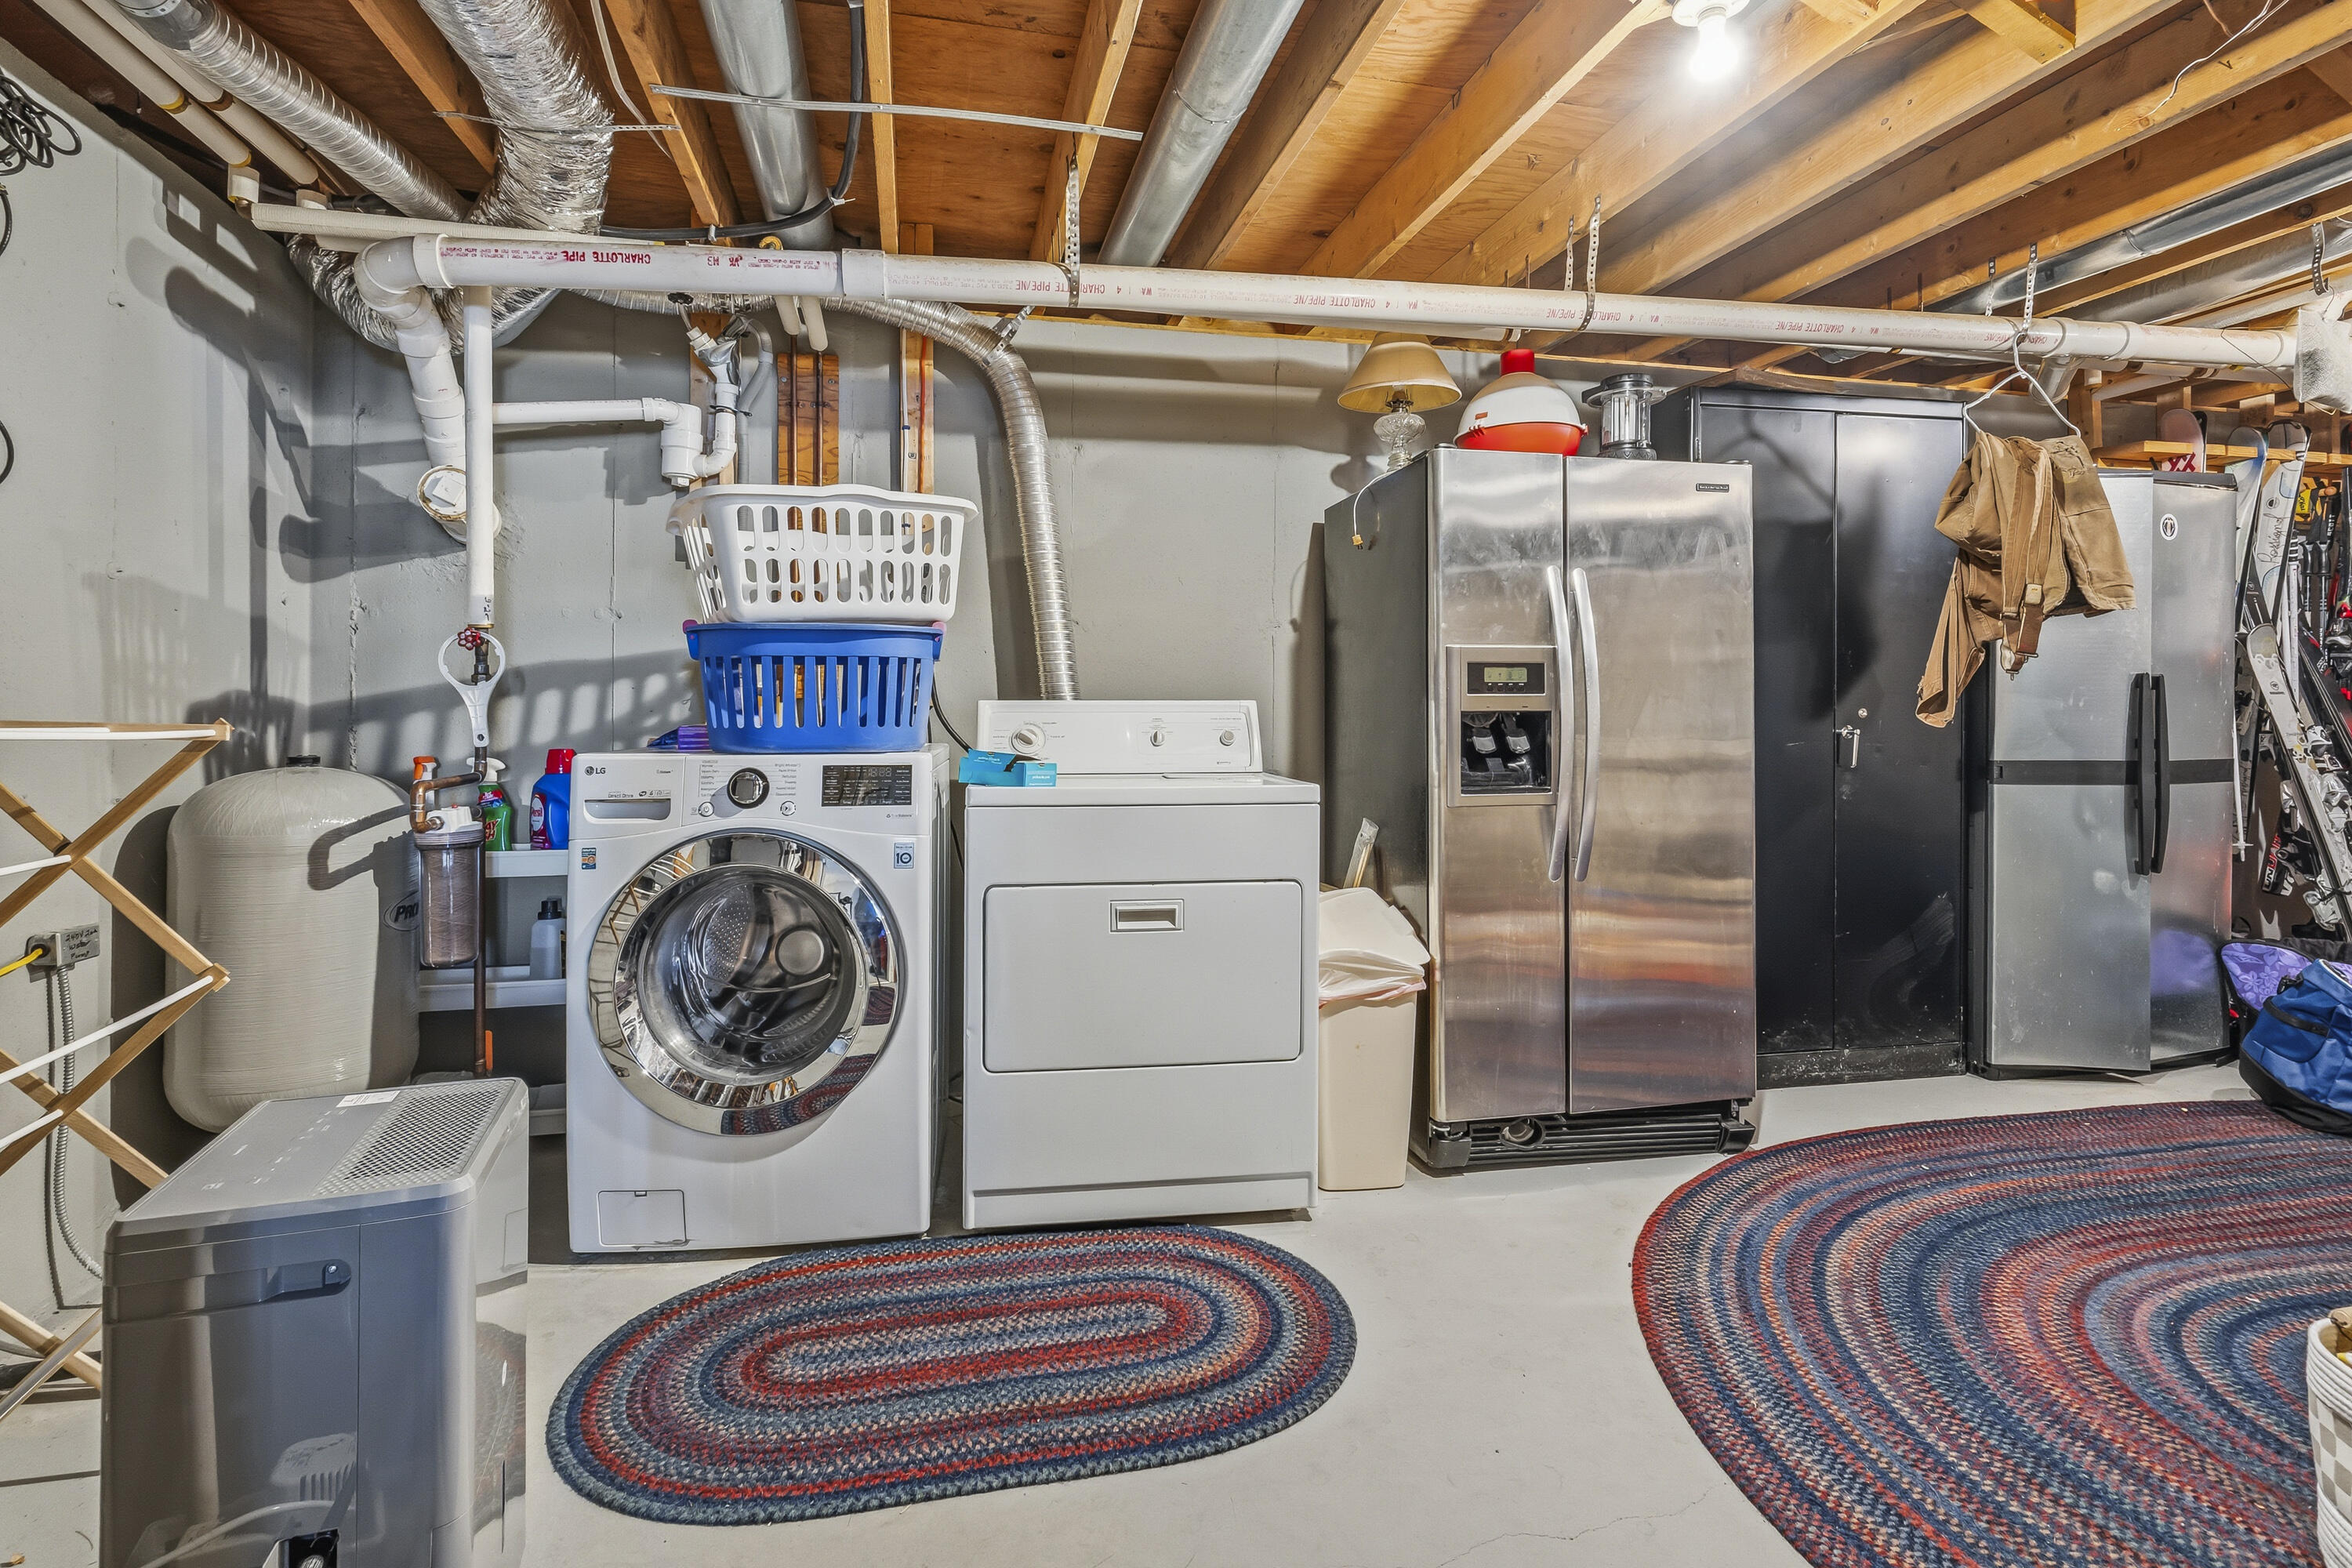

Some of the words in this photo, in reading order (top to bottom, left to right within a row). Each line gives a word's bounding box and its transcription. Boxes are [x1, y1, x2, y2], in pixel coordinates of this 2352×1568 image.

[561, 250, 586, 262] PIPE
[592, 251, 651, 264] CHARLOTTE
[707, 256, 719, 267] M3
[1015, 280, 1051, 292] PIPE/NE
[1054, 281, 1105, 294] CHARTTE
[1116, 285, 1122, 294] 4
[1294, 294, 1327, 305] PIPE/NE
[1330, 296, 1376, 308] CHARLOTTE
[1546, 308, 1576, 319] PIPE/NE
[1578, 310, 1621, 321] CHARLOE
[1775, 321, 1803, 332] PIPE/NE
[1805, 322, 1845, 333] CHARLOTTE
[896, 852, 912, 865] 10
